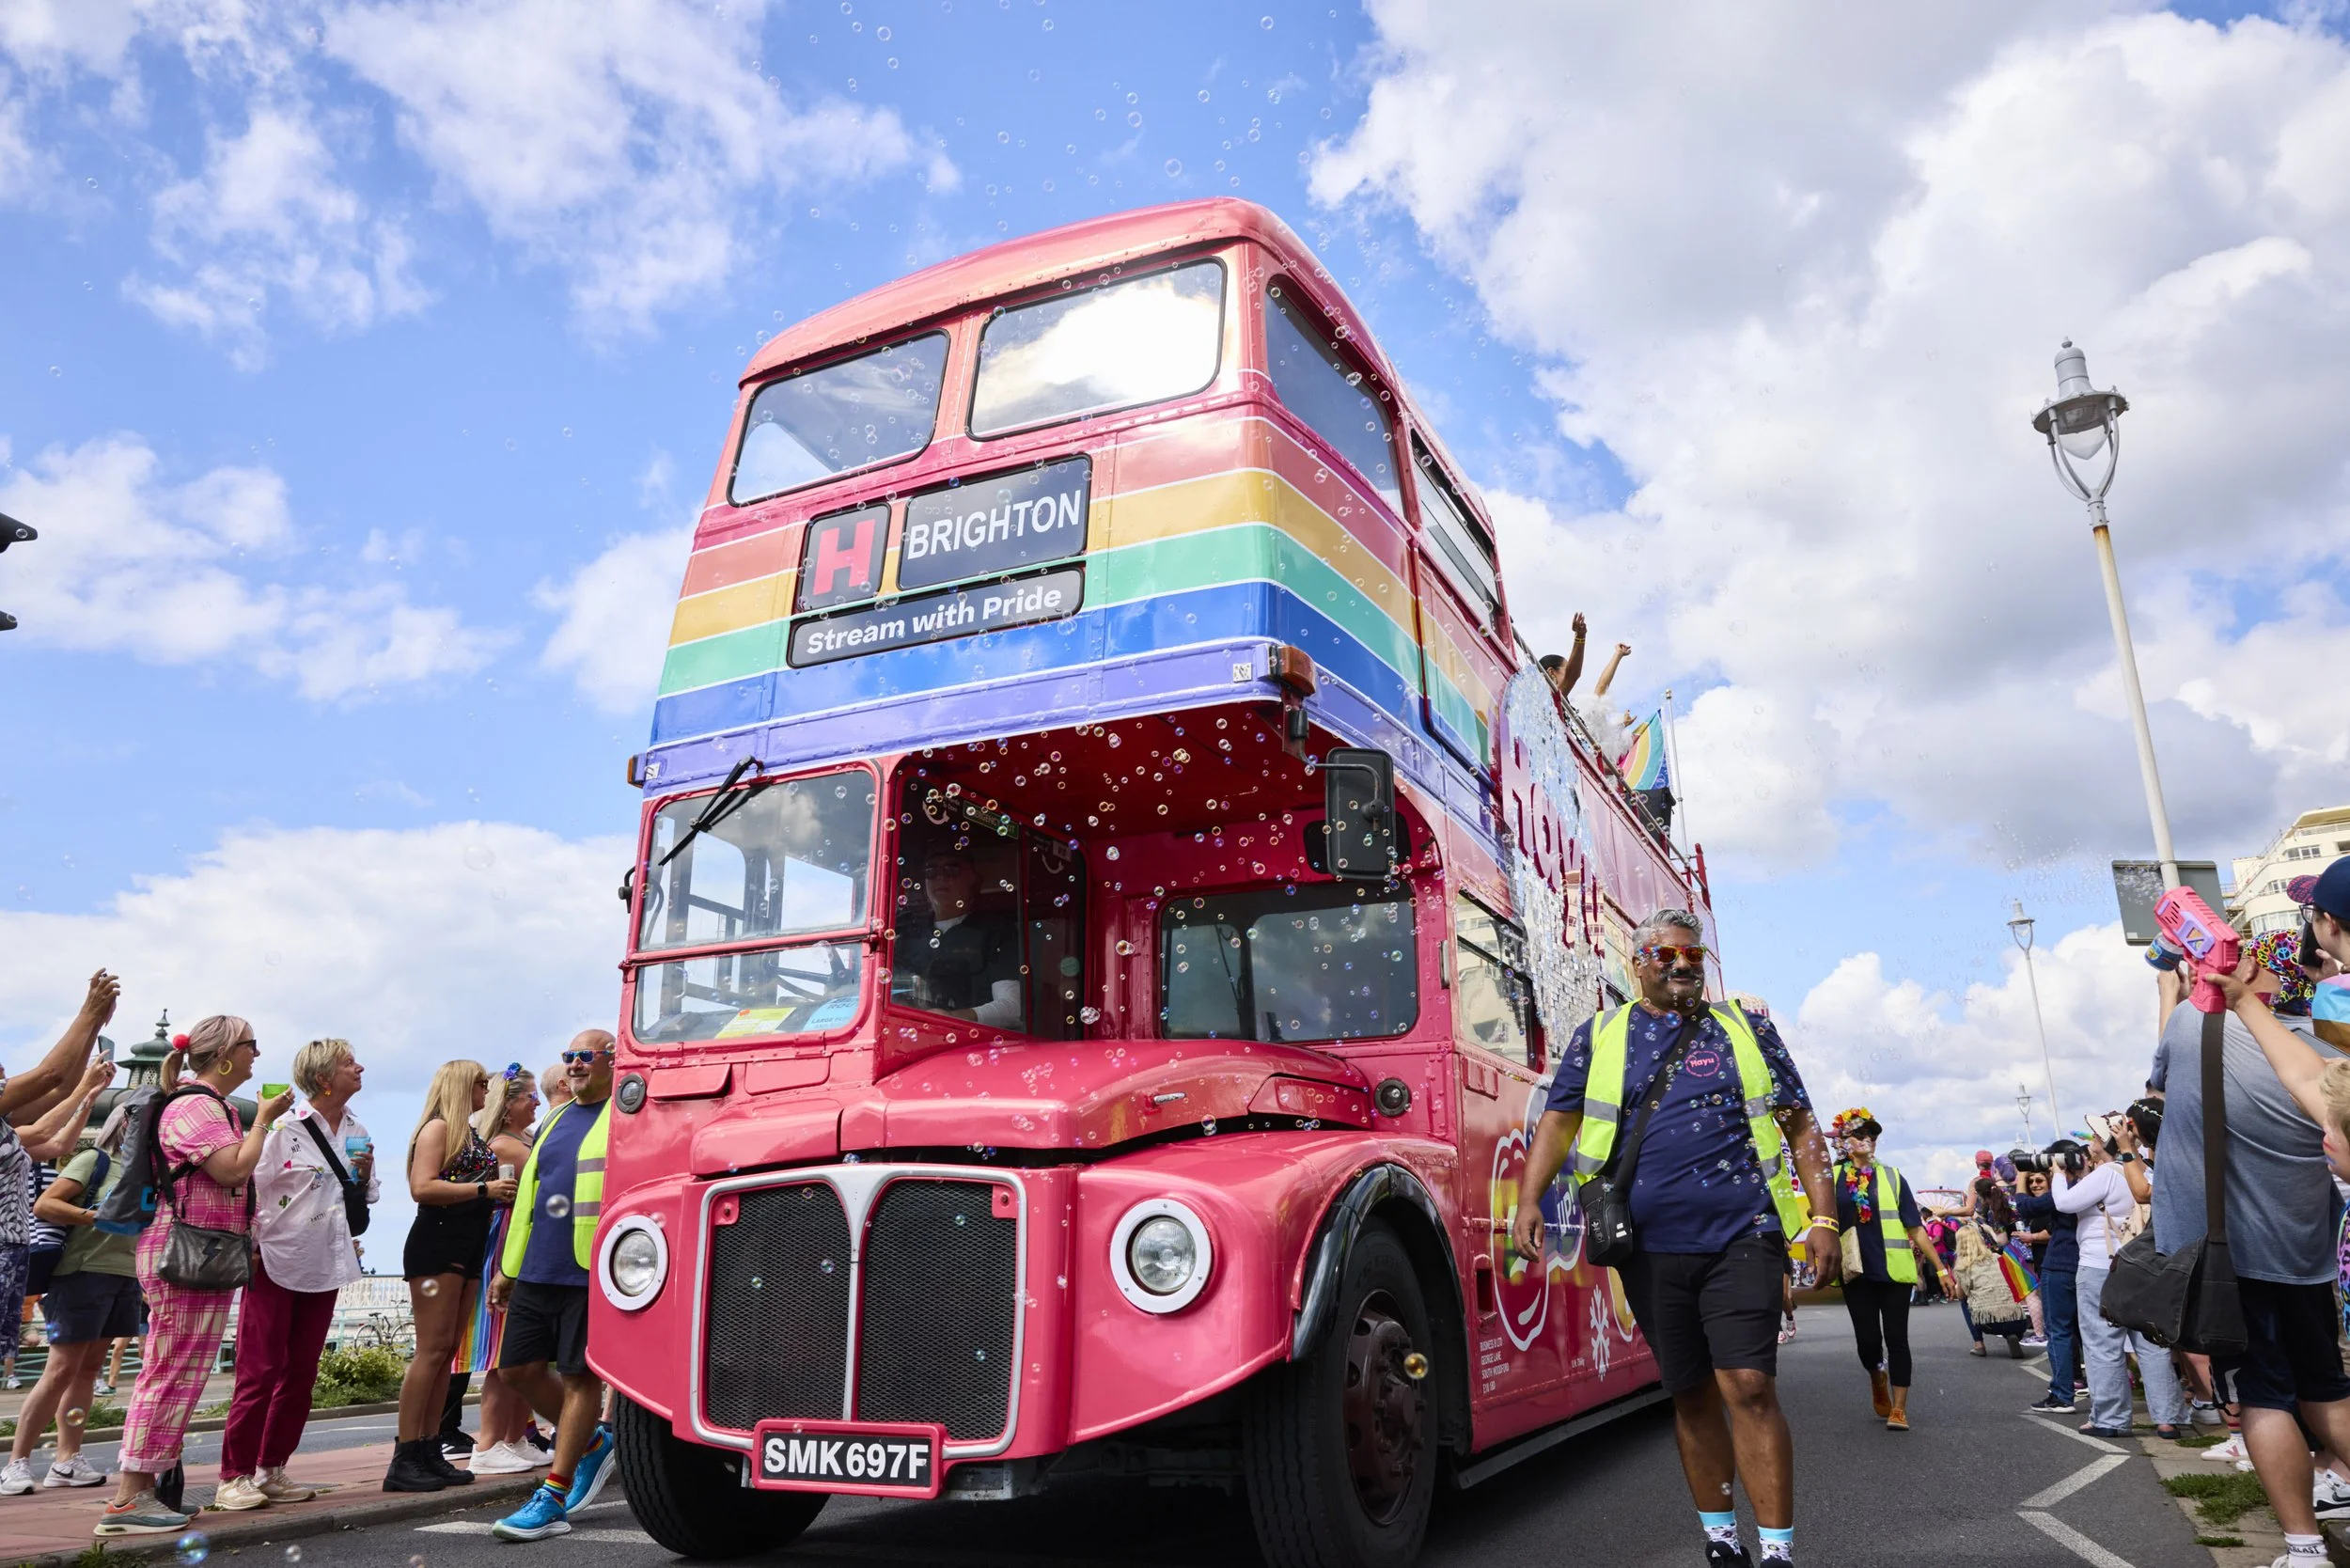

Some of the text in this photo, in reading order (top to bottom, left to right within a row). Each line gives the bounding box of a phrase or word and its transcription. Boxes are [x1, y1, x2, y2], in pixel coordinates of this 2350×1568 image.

[813, 489, 1081, 596] H BRIGHTON
[807, 586, 1062, 654] Stream with Pride
[1689, 1058, 1716, 1069] Hayu
[764, 1437, 929, 1479] SMK697F
